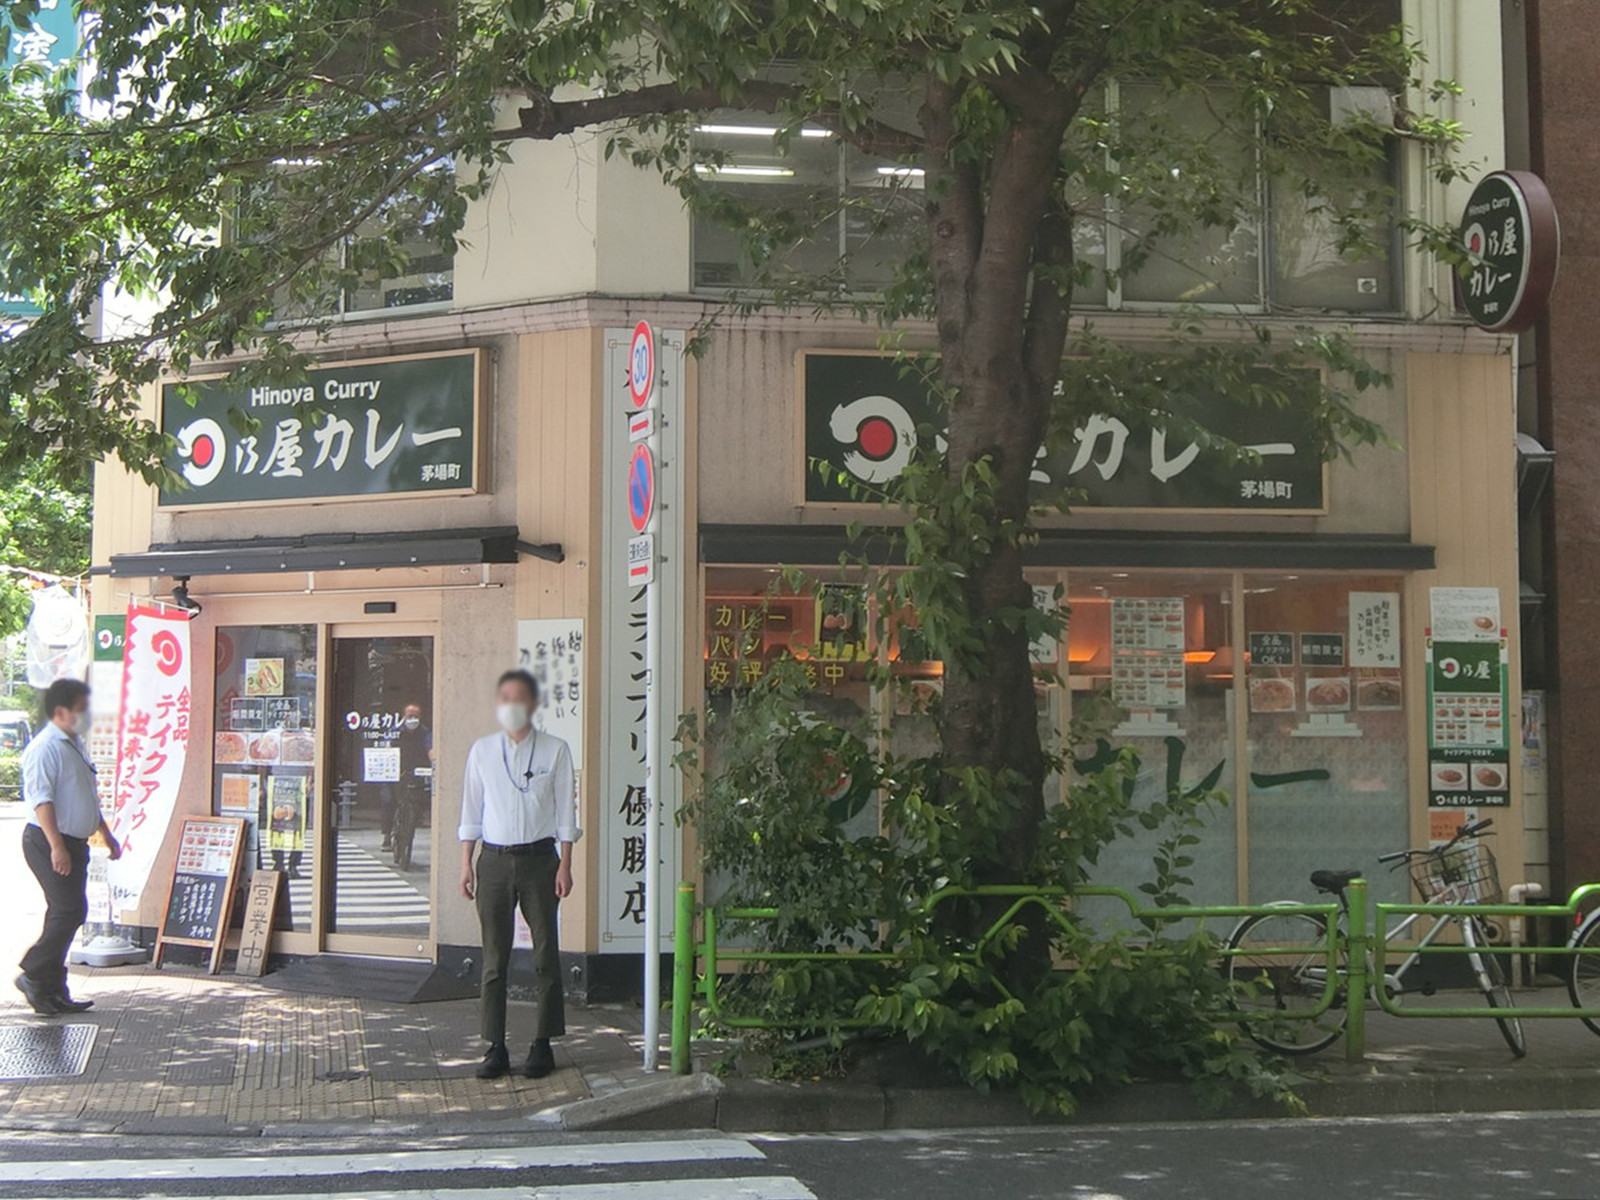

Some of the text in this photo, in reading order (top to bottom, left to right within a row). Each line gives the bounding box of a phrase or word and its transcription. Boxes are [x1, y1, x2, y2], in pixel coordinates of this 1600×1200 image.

[1491, 196, 1511, 210] Curry
[1470, 266, 1512, 297] カレー
[635, 344, 648, 384] 30
[251, 379, 381, 407] Hinoya Curry
[421, 464, 461, 482] 茅場町
[1240, 480, 1293, 500] 茅場町
[715, 605, 787, 630] カレー
[711, 636, 760, 657] パン
[709, 661, 845, 689] 好評中
